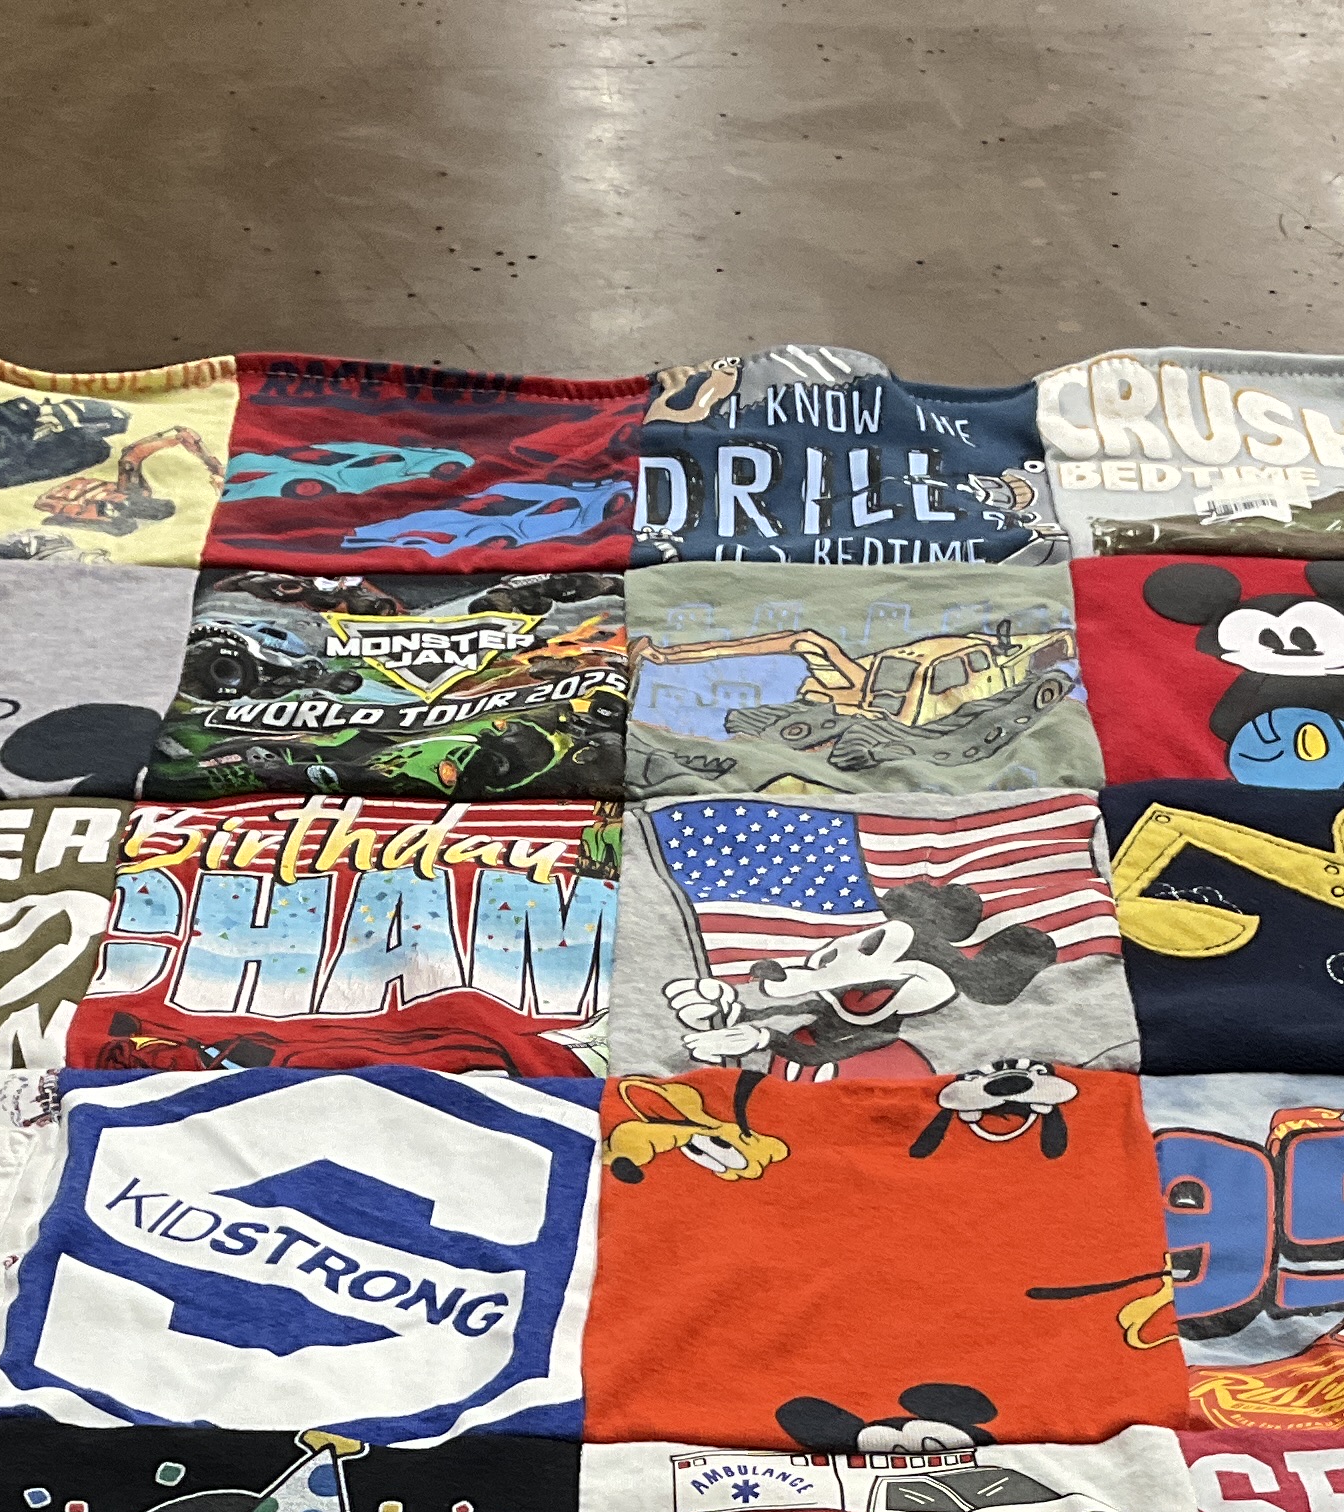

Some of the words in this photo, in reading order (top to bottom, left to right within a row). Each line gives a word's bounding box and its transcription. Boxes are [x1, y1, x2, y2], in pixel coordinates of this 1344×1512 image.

[766, 382, 883, 434] KNOW
[632, 444, 958, 538] DRILL
[813, 536, 986, 565] BEDTIME
[325, 630, 536, 659] MONSTER
[384, 650, 478, 671] JAM
[225, 700, 385, 729] WORLD
[398, 690, 518, 728] TOUR
[524, 671, 630, 704] 2025
[116, 794, 569, 885] Birthday
[105, 1177, 510, 1338] KIDSTRONG
[690, 1464, 814, 1495] AMBULANCE
